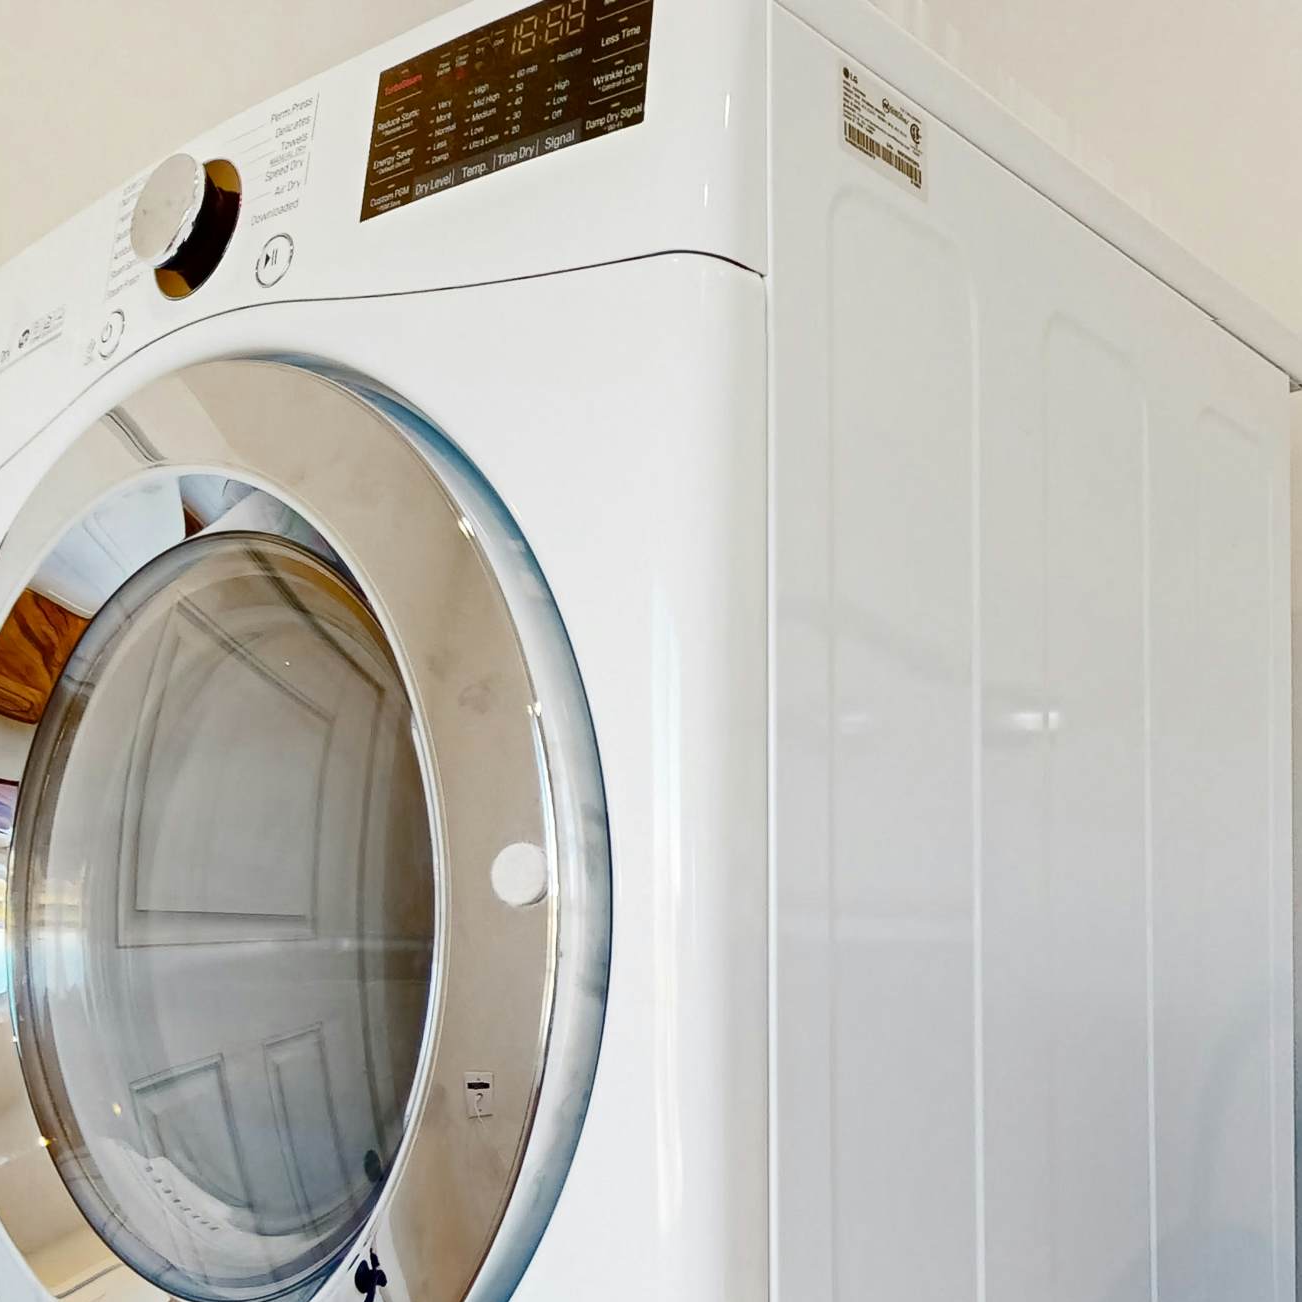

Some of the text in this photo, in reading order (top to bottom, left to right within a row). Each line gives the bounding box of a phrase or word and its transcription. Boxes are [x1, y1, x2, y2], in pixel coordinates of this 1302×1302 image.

[621, 25, 641, 39] Time
[593, 62, 644, 86] Wrinkle Care
[552, 95, 568, 105] Low
[585, 102, 643, 130] Damp Dry Signal
[470, 126, 484, 136] Low
[485, 134, 499, 145] Low
[545, 129, 575, 151] Signal
[498, 144, 535, 166] Time Dry
[461, 162, 488, 178] Temp.
[415, 171, 452, 197] Dry Level
